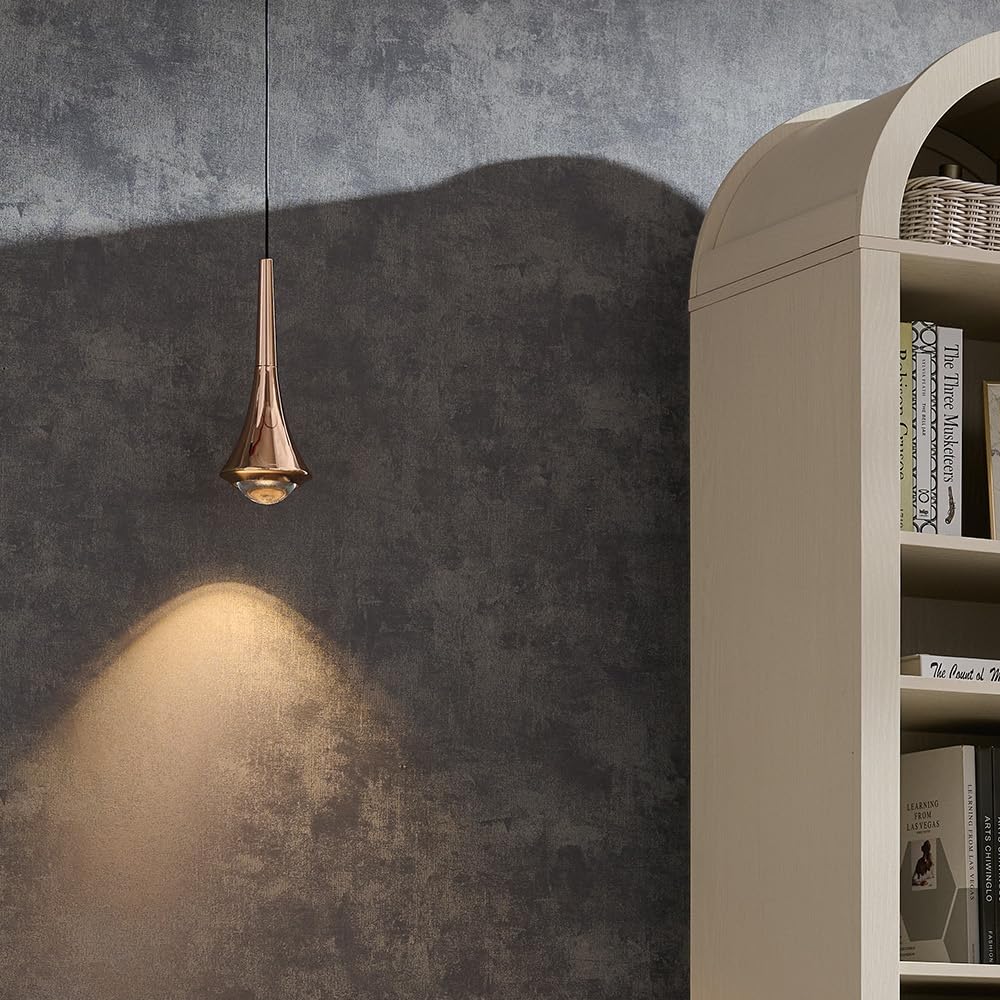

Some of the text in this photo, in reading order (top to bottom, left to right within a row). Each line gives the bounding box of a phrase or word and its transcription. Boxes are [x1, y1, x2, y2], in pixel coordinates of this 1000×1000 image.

[943, 344, 959, 482] The Three Musketeers
[930, 662, 946, 678] The
[949, 664, 974, 680] Count
[907, 800, 939, 811] LEARNING
[914, 811, 932, 820] FROM
[984, 815, 992, 841] ARTS
[985, 845, 993, 902] CHIWINGLO
